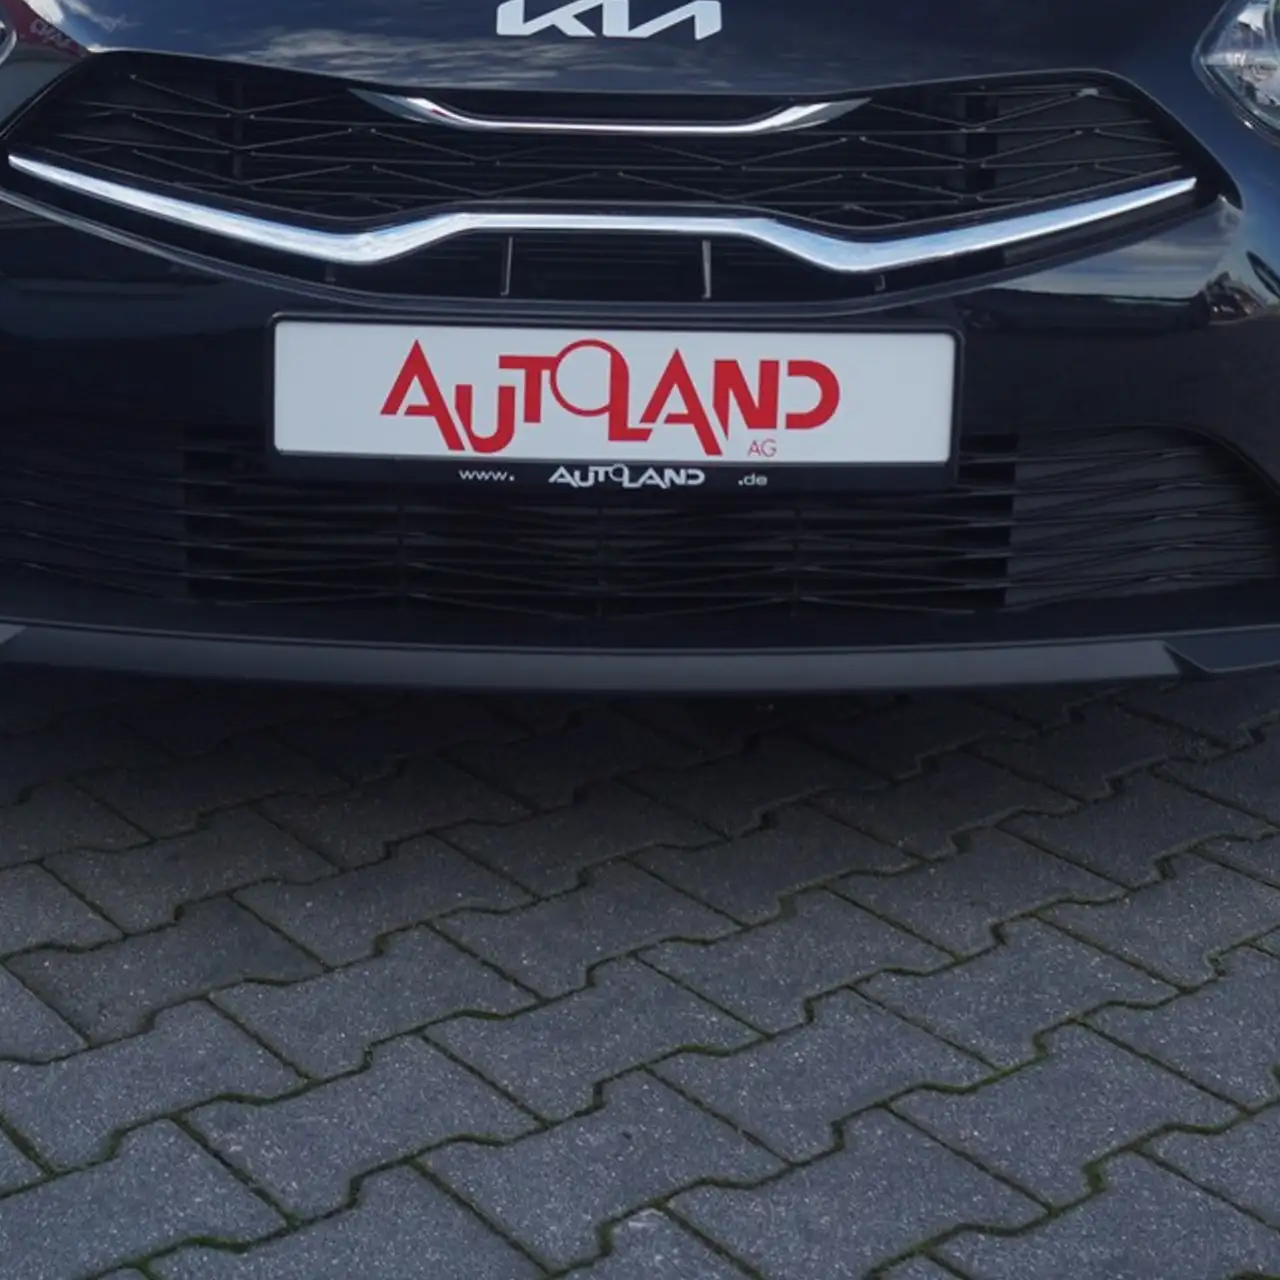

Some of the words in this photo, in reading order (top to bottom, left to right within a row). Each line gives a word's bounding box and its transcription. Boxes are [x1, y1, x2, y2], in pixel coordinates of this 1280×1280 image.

[380, 339, 840, 456] AUTOLAND
[747, 439, 777, 458] AG
[548, 464, 706, 488] AUTOLAND
